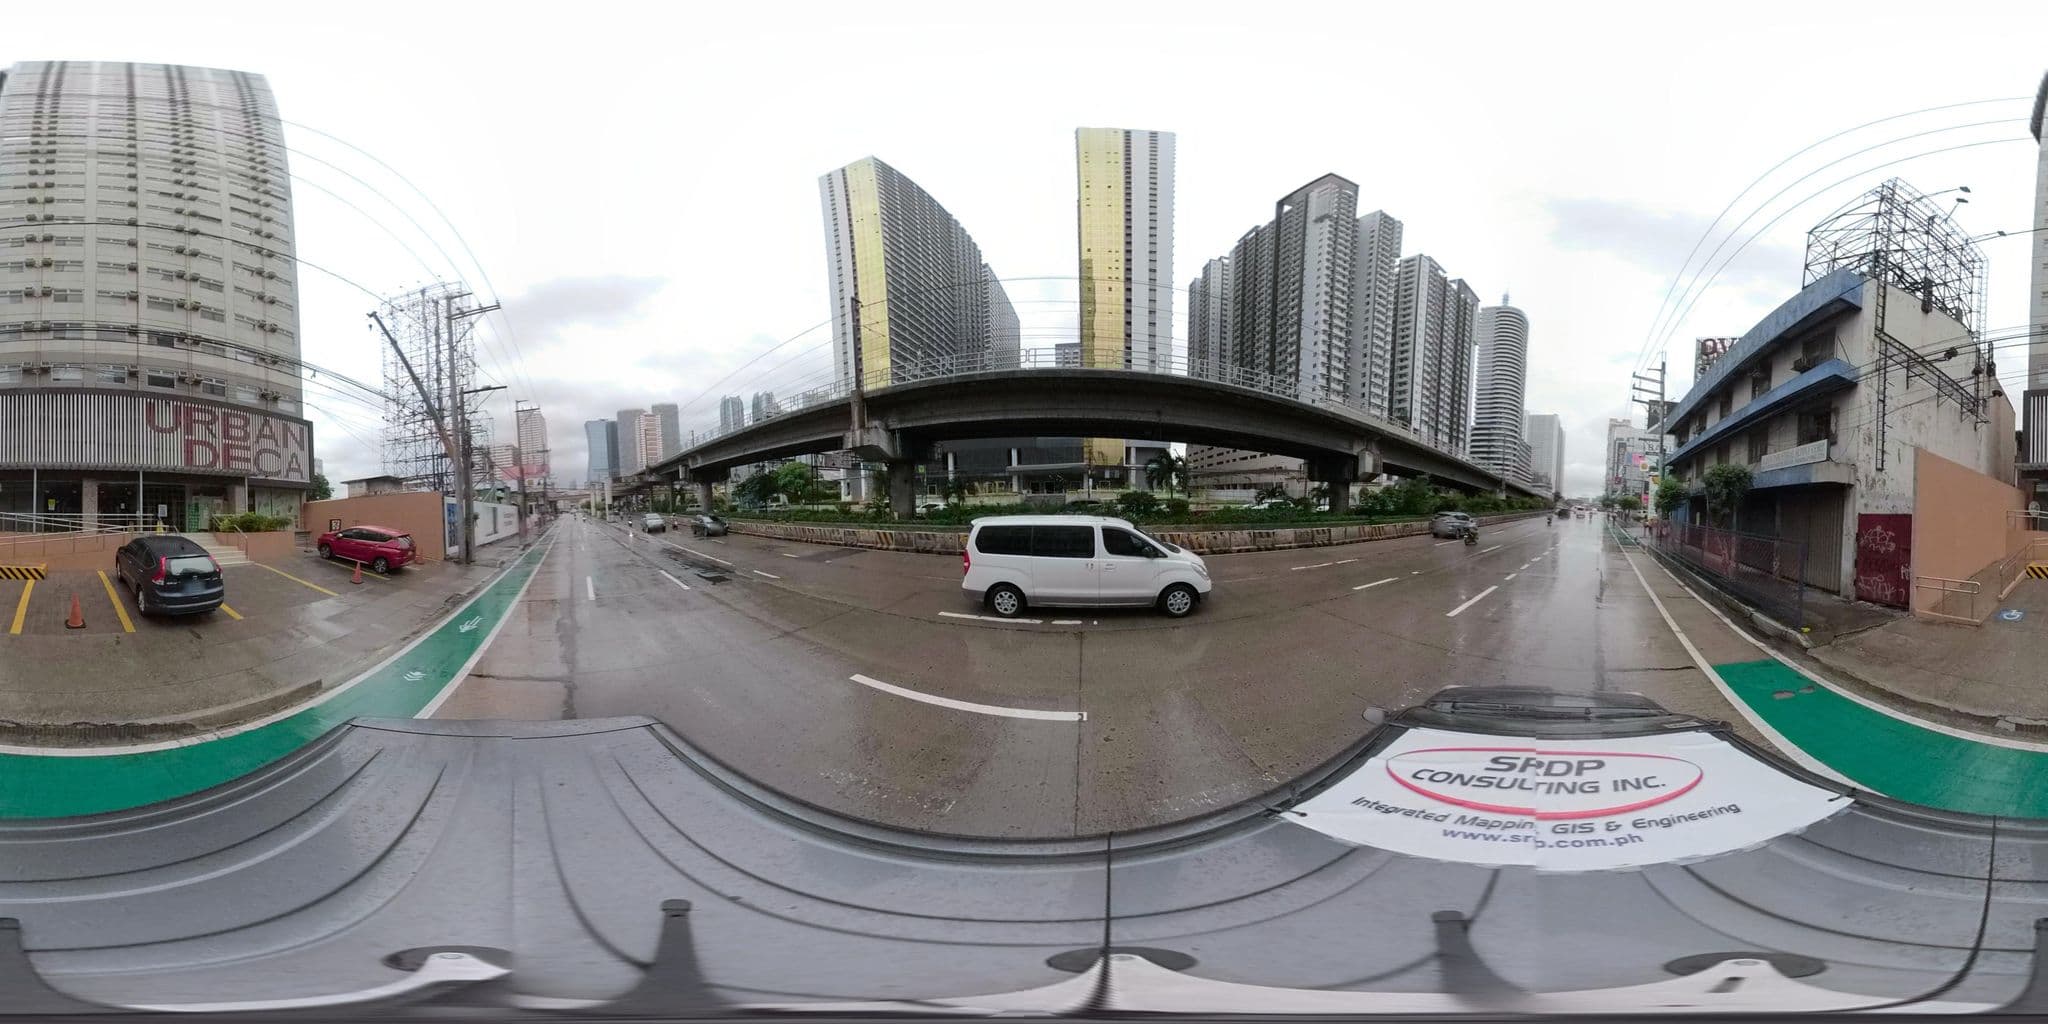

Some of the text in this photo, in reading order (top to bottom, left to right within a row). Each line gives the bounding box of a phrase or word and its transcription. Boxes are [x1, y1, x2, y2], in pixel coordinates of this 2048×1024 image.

[146, 402, 304, 451] URBAN
[185, 438, 304, 479] DECA
[1411, 768, 1667, 795] CONSULTING INC.
[1485, 755, 1605, 777] SRDP
[1351, 796, 1450, 823] Integrated
[1552, 821, 1595, 834] GIS
[1605, 820, 1622, 832] &
[1631, 803, 1742, 830] Engineering
